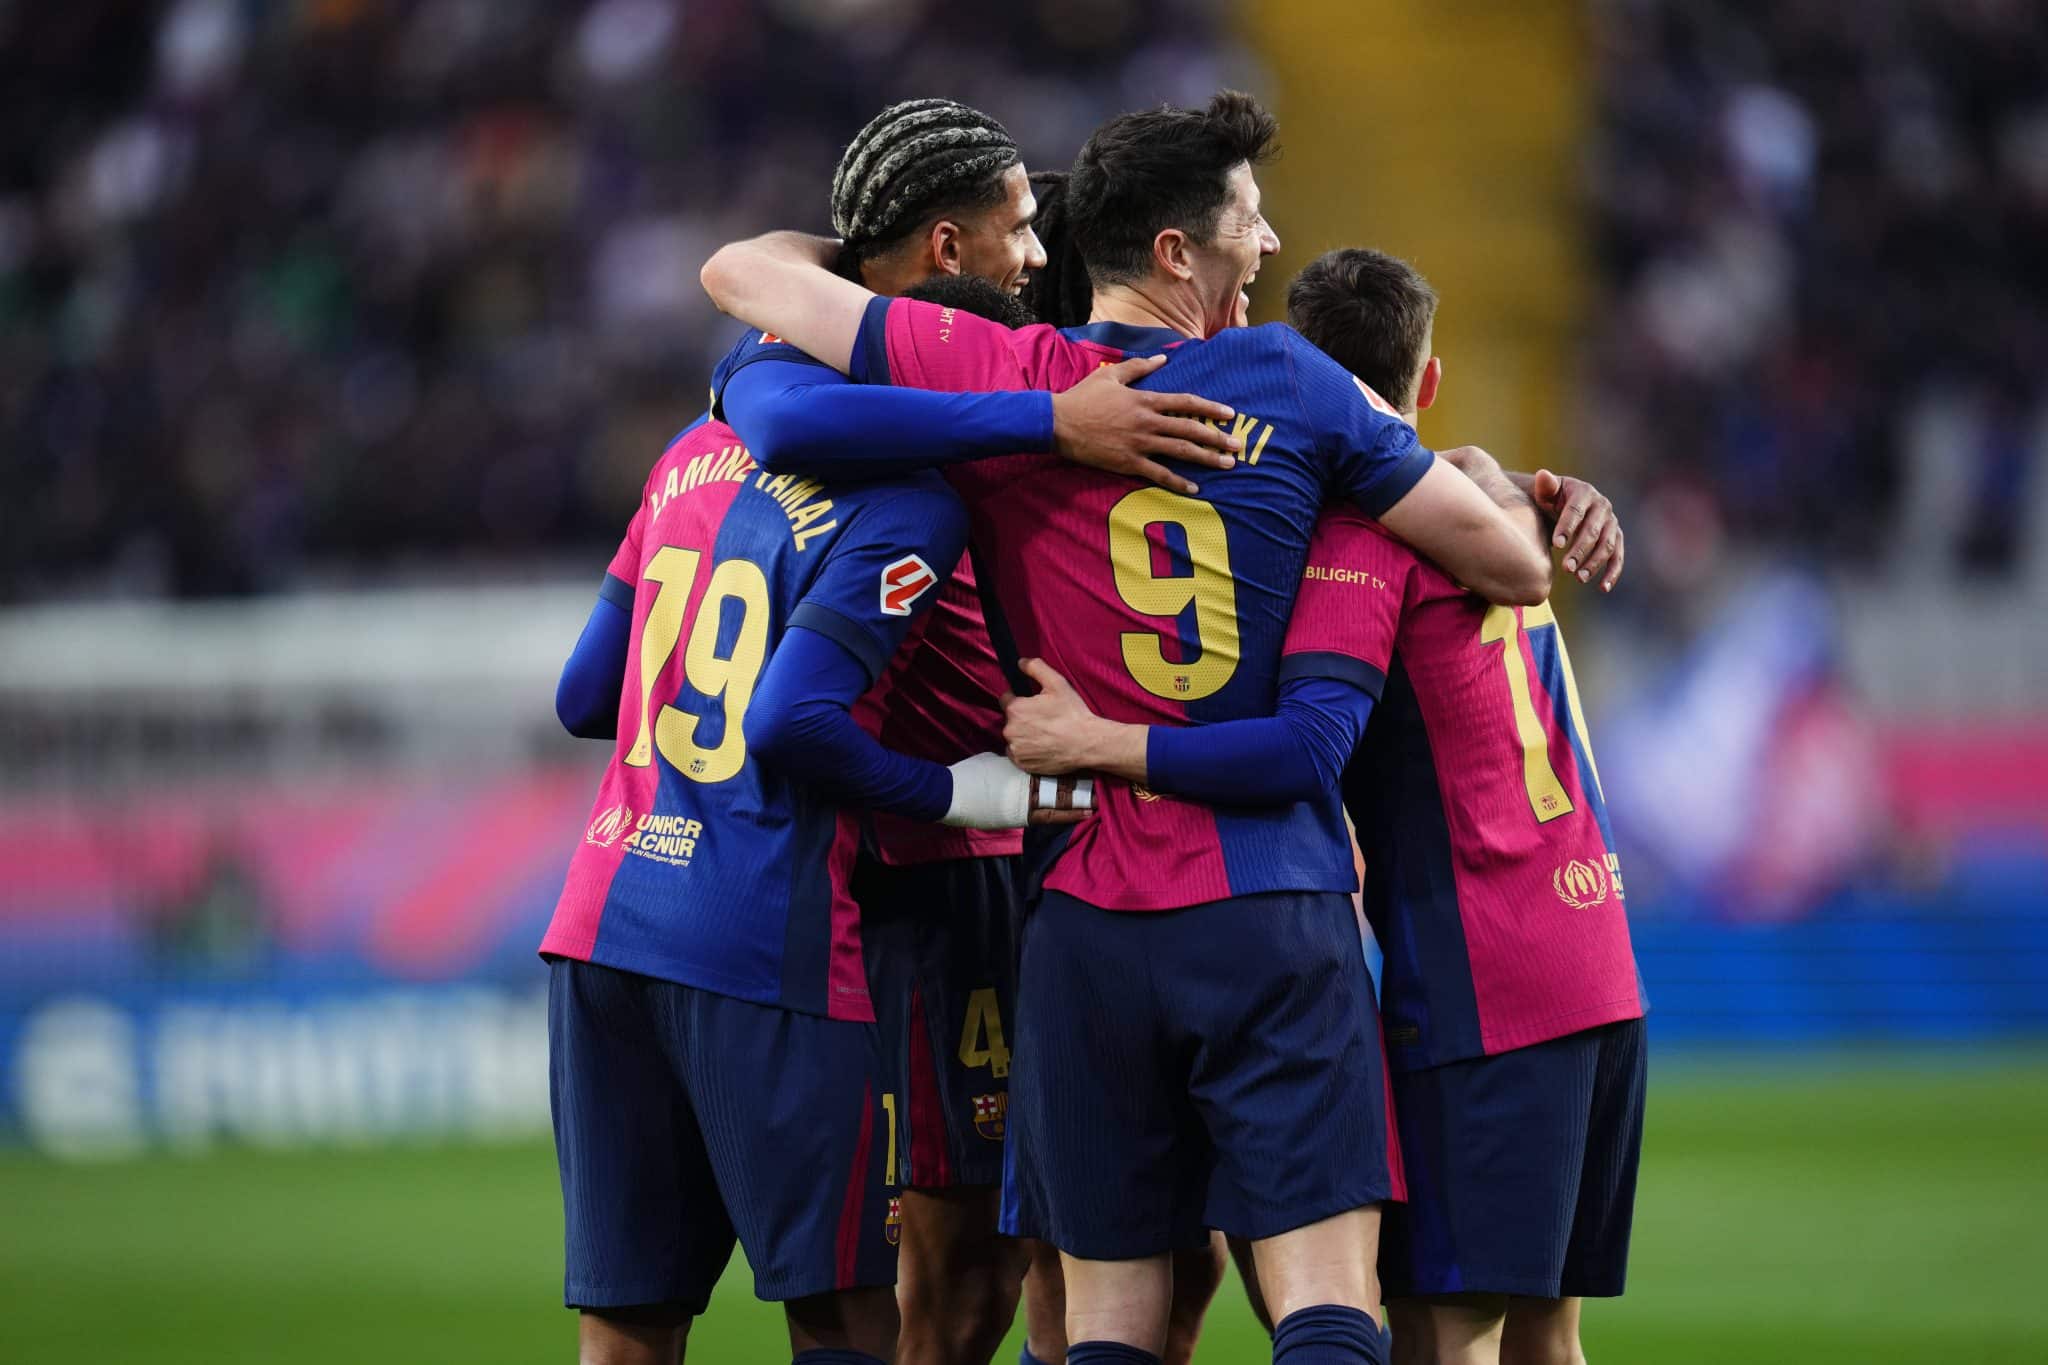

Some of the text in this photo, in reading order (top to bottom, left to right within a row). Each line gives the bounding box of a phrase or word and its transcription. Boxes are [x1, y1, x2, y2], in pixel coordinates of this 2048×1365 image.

[940, 328, 951, 344] tv
[1108, 486, 1240, 701] 9
[1303, 566, 1386, 590] BILIGHT tv
[623, 544, 770, 784] 19
[622, 830, 696, 858] ACNUR
[636, 813, 703, 839] UNHCR
[958, 987, 1011, 1079] 4
[882, 1093, 896, 1186] 1
